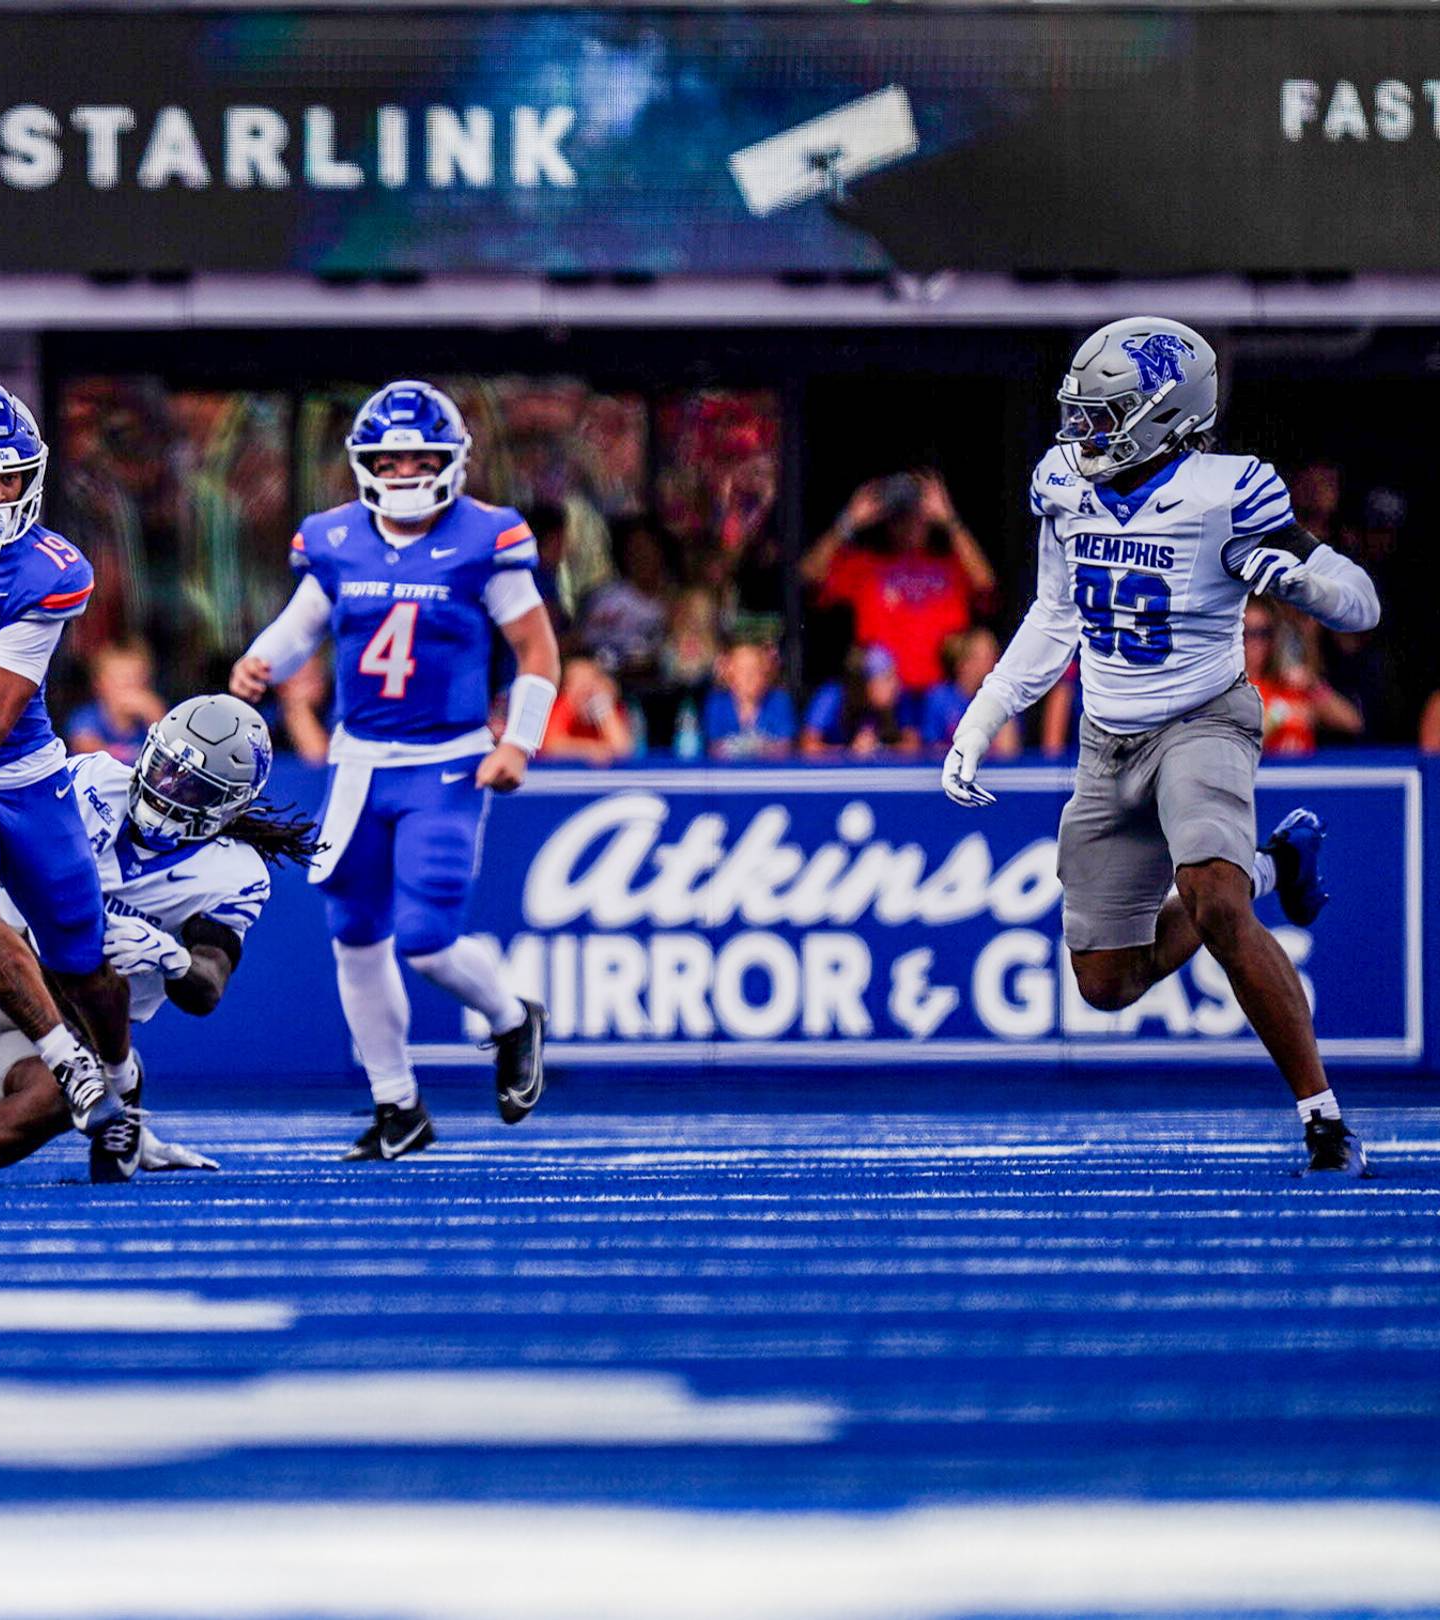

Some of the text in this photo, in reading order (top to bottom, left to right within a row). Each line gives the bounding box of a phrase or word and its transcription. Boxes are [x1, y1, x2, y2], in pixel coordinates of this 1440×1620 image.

[33, 536, 80, 571] 19
[1074, 534, 1175, 569] MEMPHIS
[359, 601, 418, 698] 4
[1074, 563, 1173, 665] 93
[522, 790, 1064, 928] Atkinso
[890, 947, 958, 1040] &
